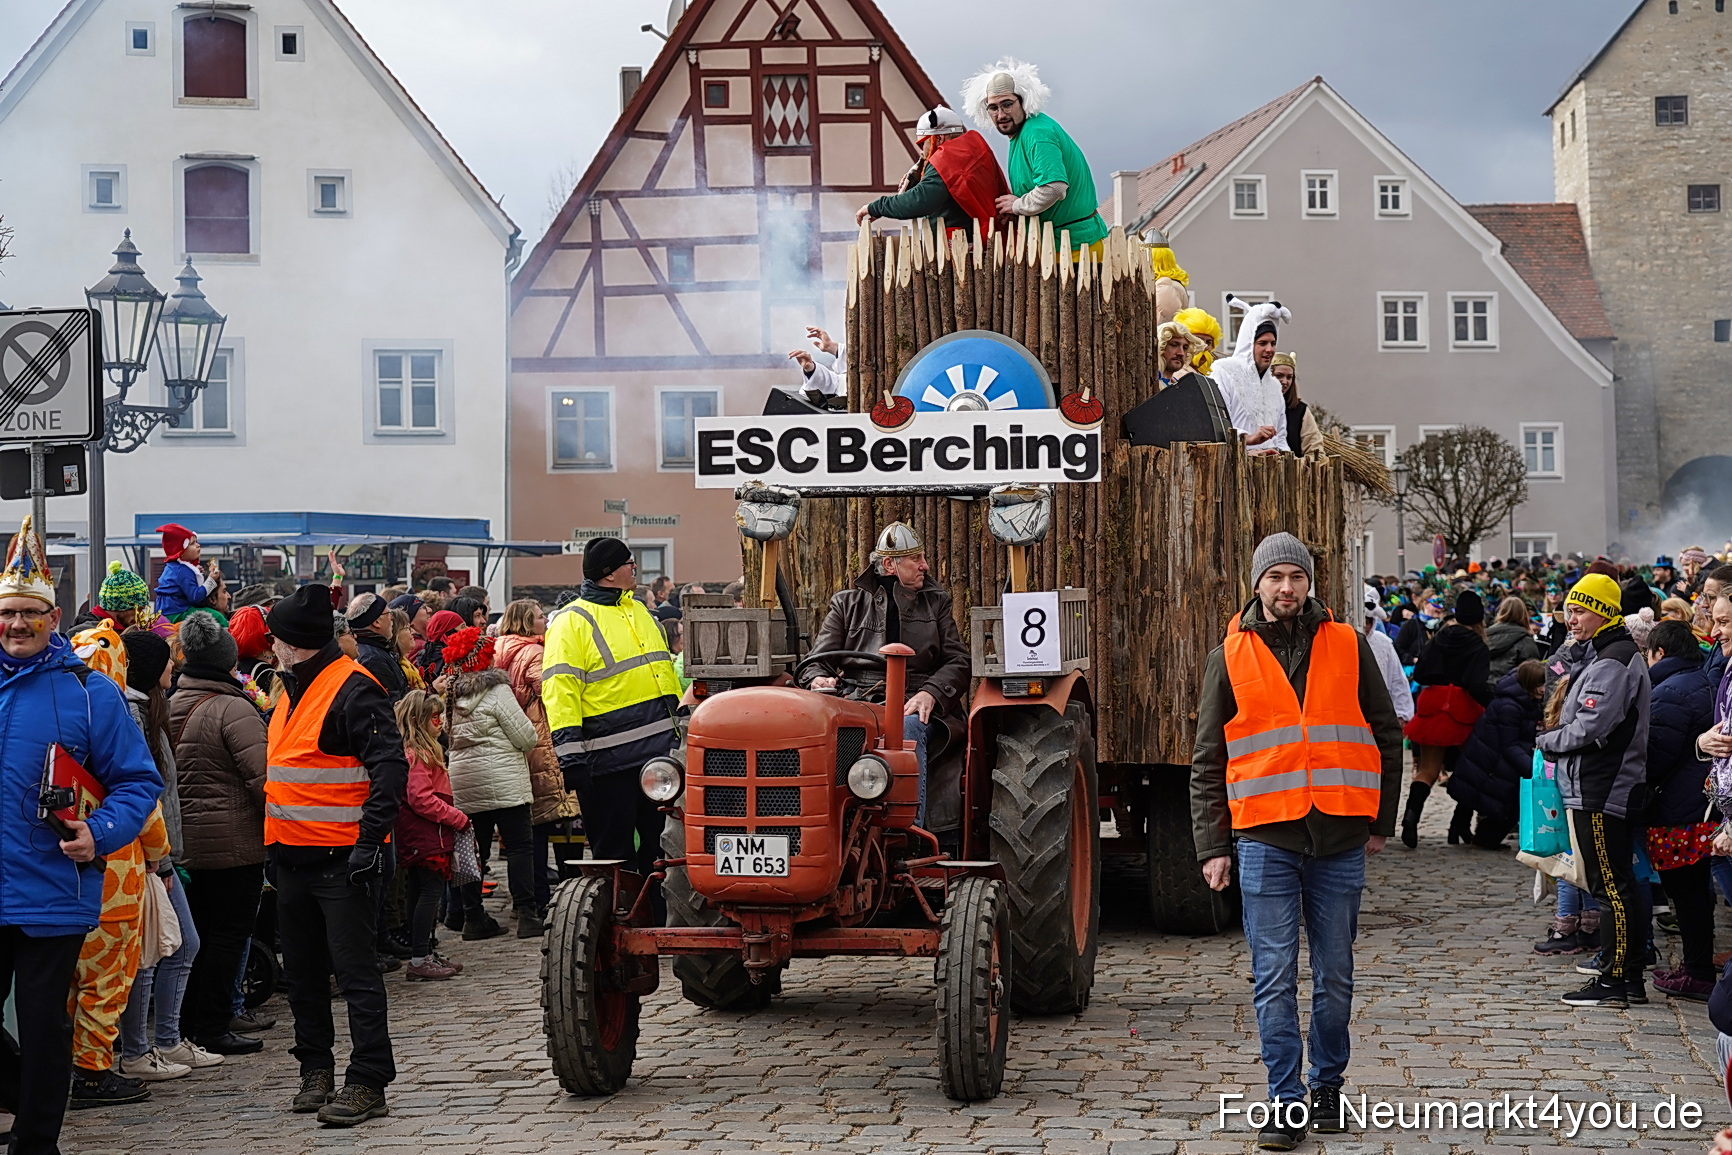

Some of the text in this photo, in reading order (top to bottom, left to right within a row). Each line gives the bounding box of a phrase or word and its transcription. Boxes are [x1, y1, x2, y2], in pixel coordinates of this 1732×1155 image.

[4, 410, 61, 431] ZONE
[698, 424, 1099, 481] ESC Berching
[632, 516, 676, 525] Probststraße
[1021, 608, 1046, 647] 8
[737, 838, 765, 855] NM
[720, 856, 785, 874] AT 653
